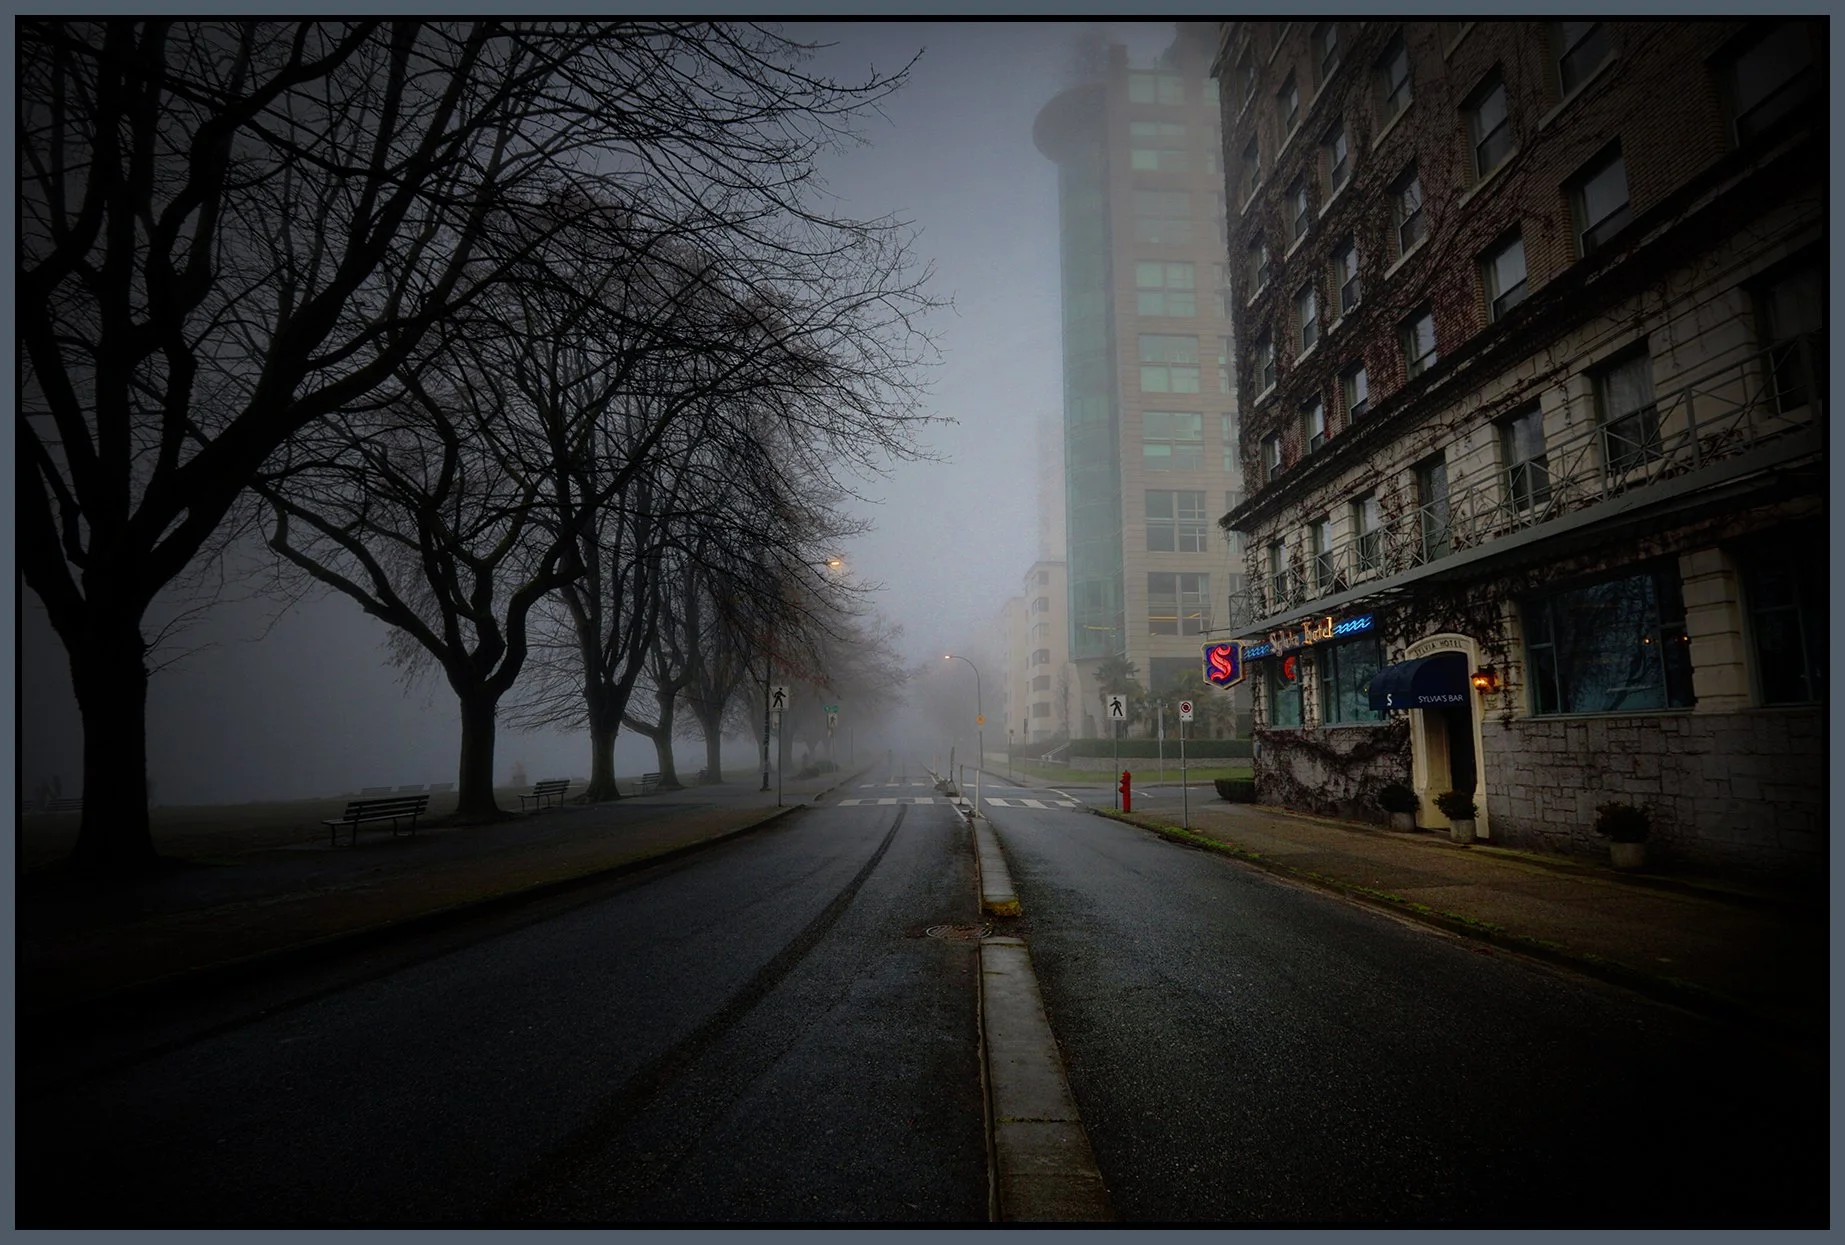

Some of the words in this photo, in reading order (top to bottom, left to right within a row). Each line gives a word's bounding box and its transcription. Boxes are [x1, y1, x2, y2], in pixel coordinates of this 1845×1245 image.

[1440, 639, 1462, 648] HOTEL
[1209, 645, 1233, 681] S
[1386, 693, 1393, 707] S
[1418, 695, 1447, 703] SYLVIA'S
[1448, 694, 1464, 703] BAR
